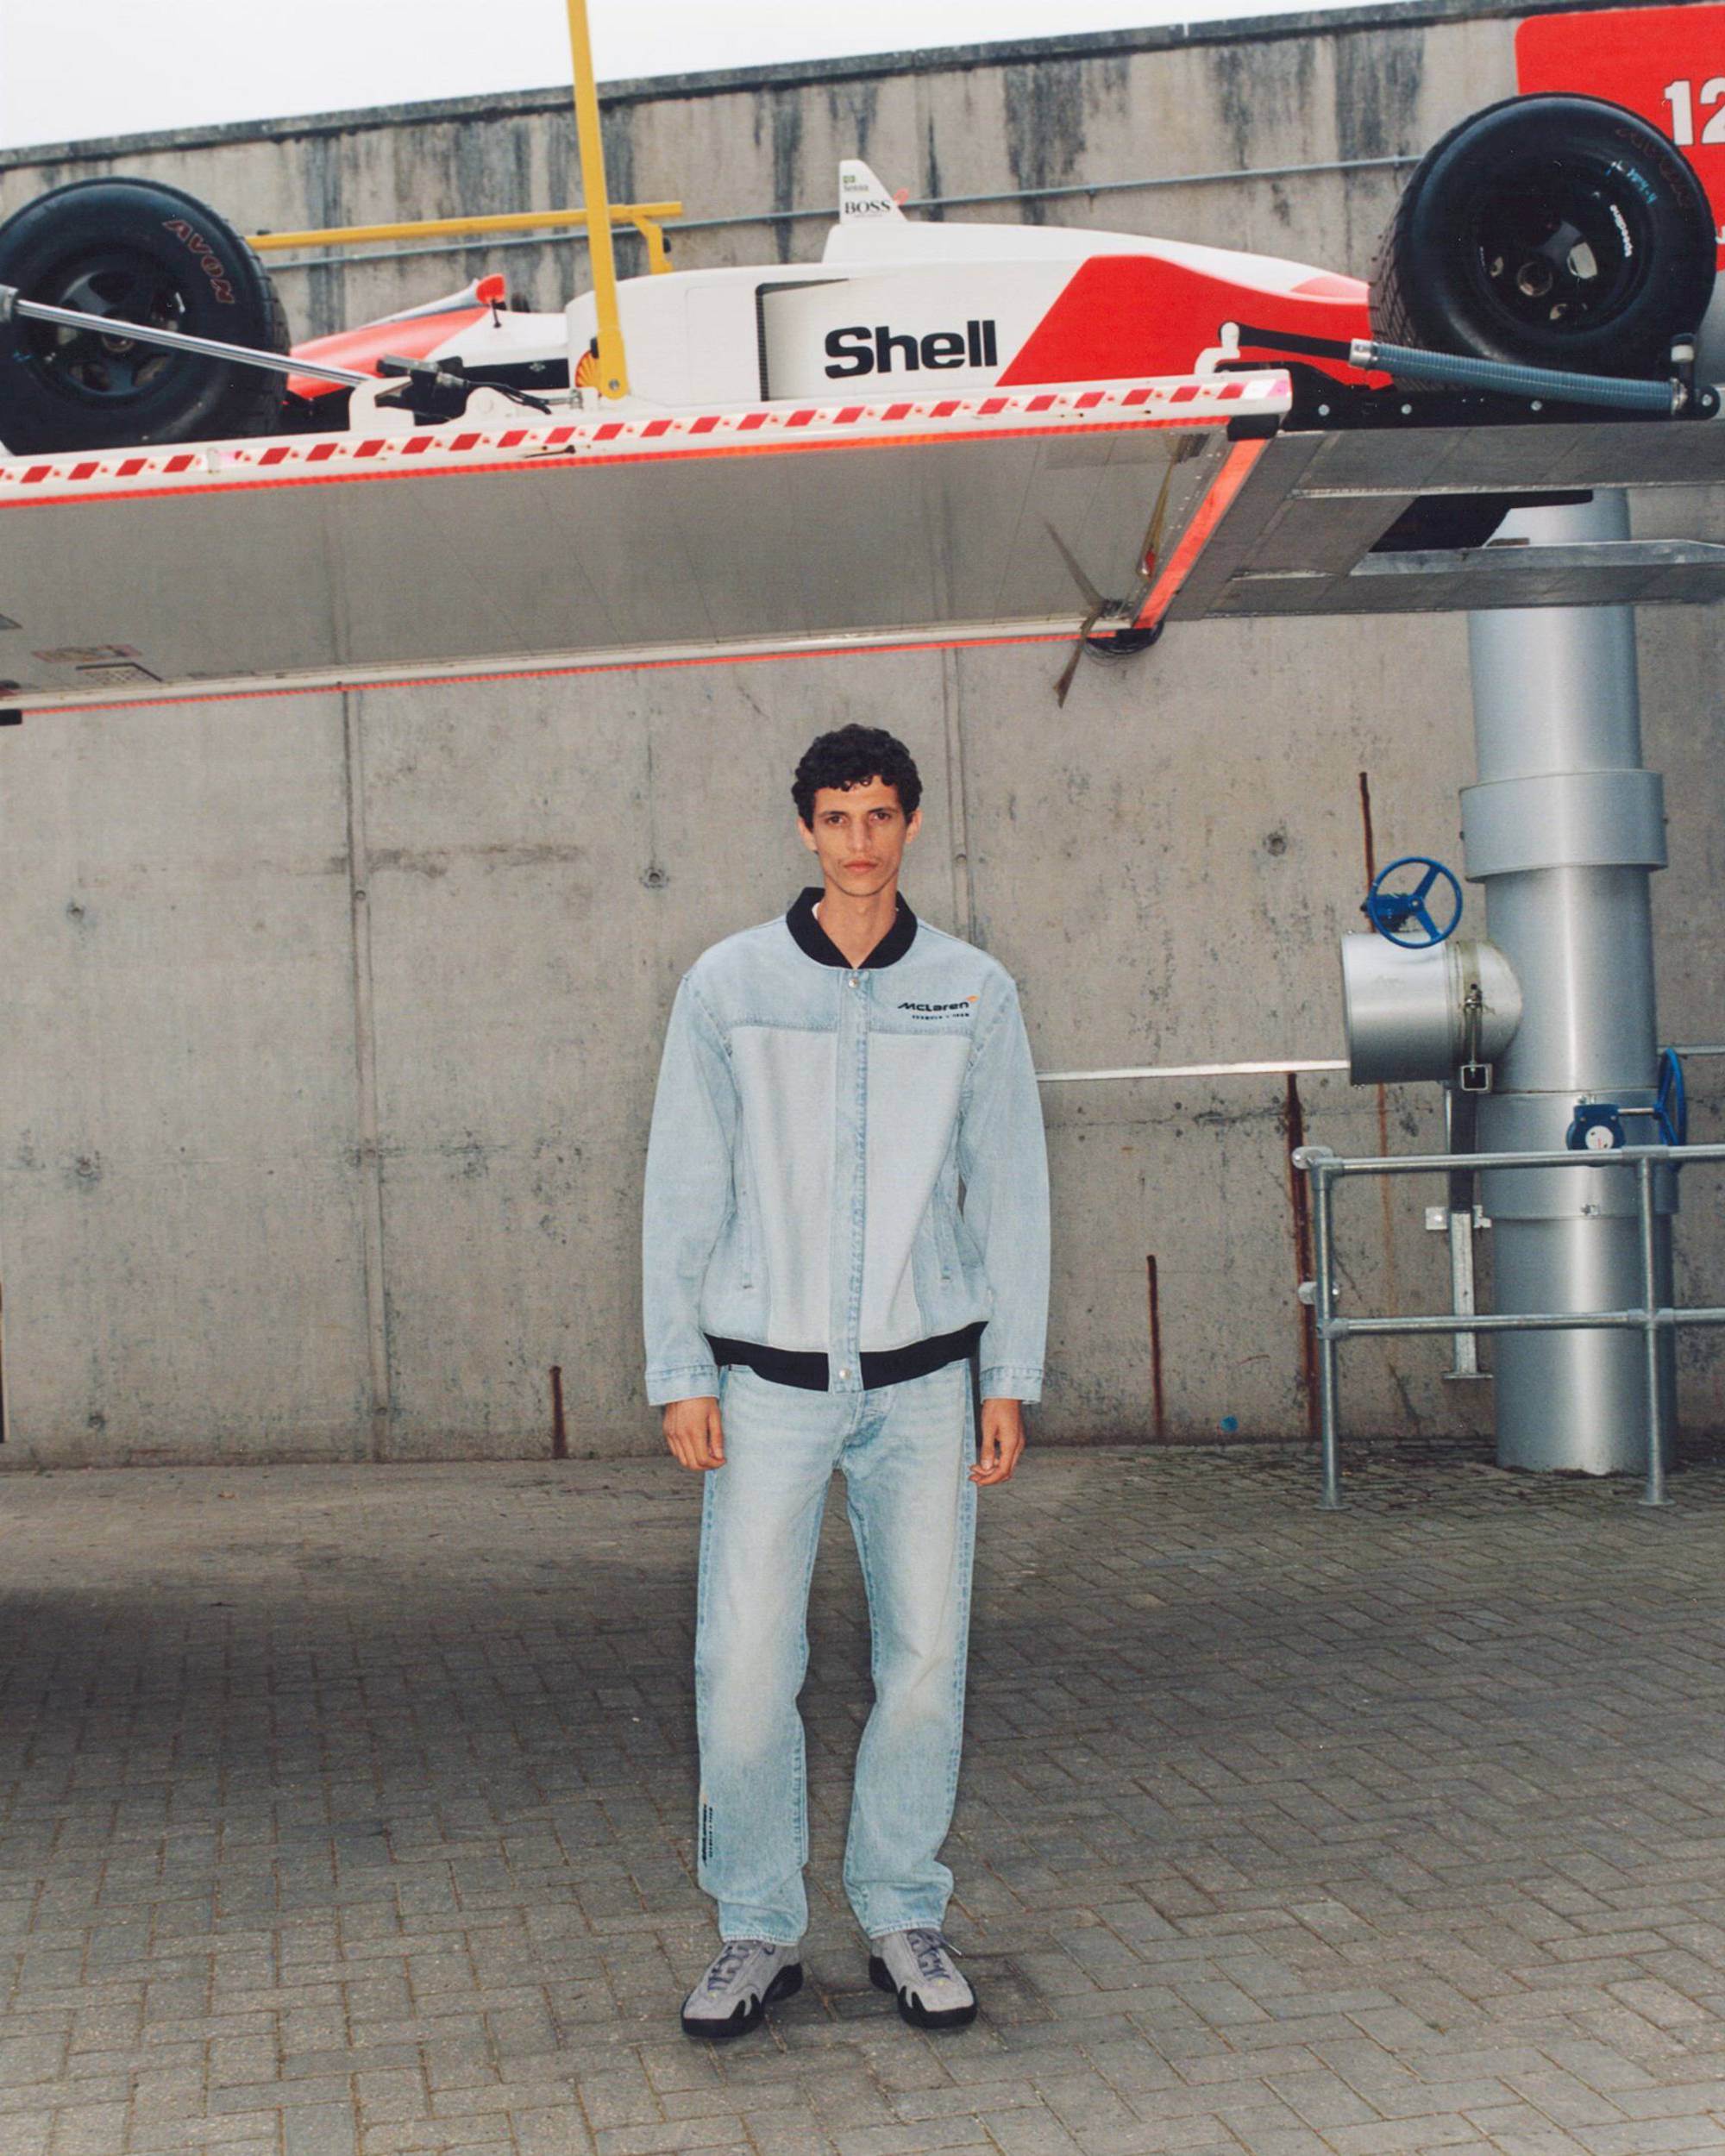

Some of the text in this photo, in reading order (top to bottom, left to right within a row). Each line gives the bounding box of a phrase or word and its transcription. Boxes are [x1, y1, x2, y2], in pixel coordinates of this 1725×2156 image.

[1665, 77, 1725, 146] 12
[844, 200, 891, 215] BOSS
[161, 220, 235, 304] AVON
[825, 320, 998, 379] Shell
[897, 1001, 969, 1012] McLaren
